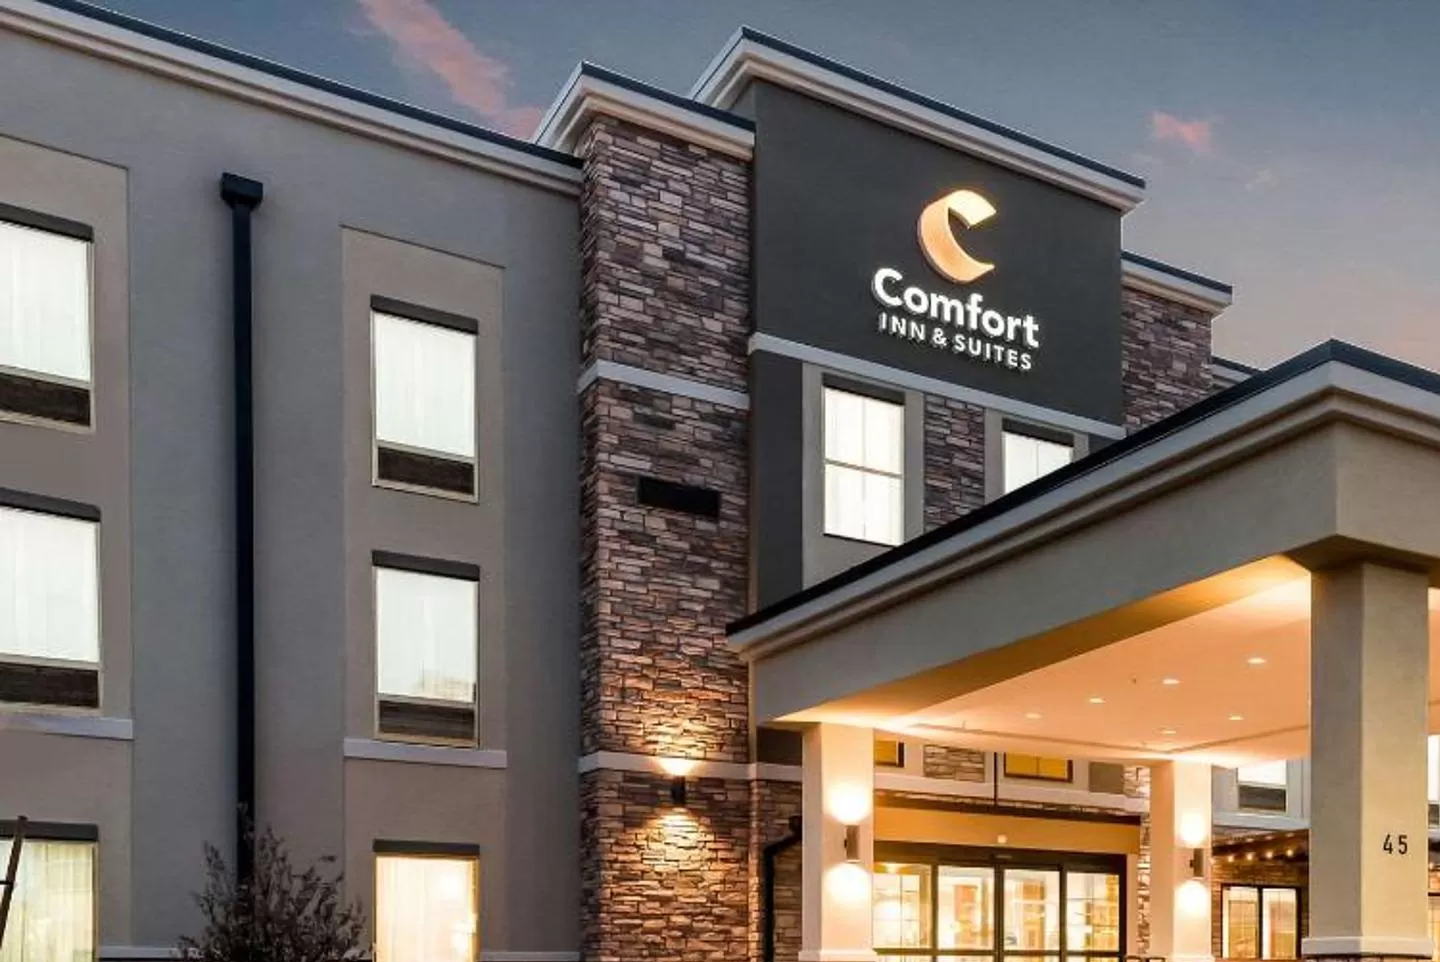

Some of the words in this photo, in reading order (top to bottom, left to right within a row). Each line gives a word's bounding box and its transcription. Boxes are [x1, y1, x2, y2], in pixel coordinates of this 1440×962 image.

[872, 267, 1040, 348] Comfort
[878, 312, 926, 341] INN
[931, 327, 948, 347] &
[952, 333, 1033, 370] SUITES
[1382, 833, 1408, 855] 45
